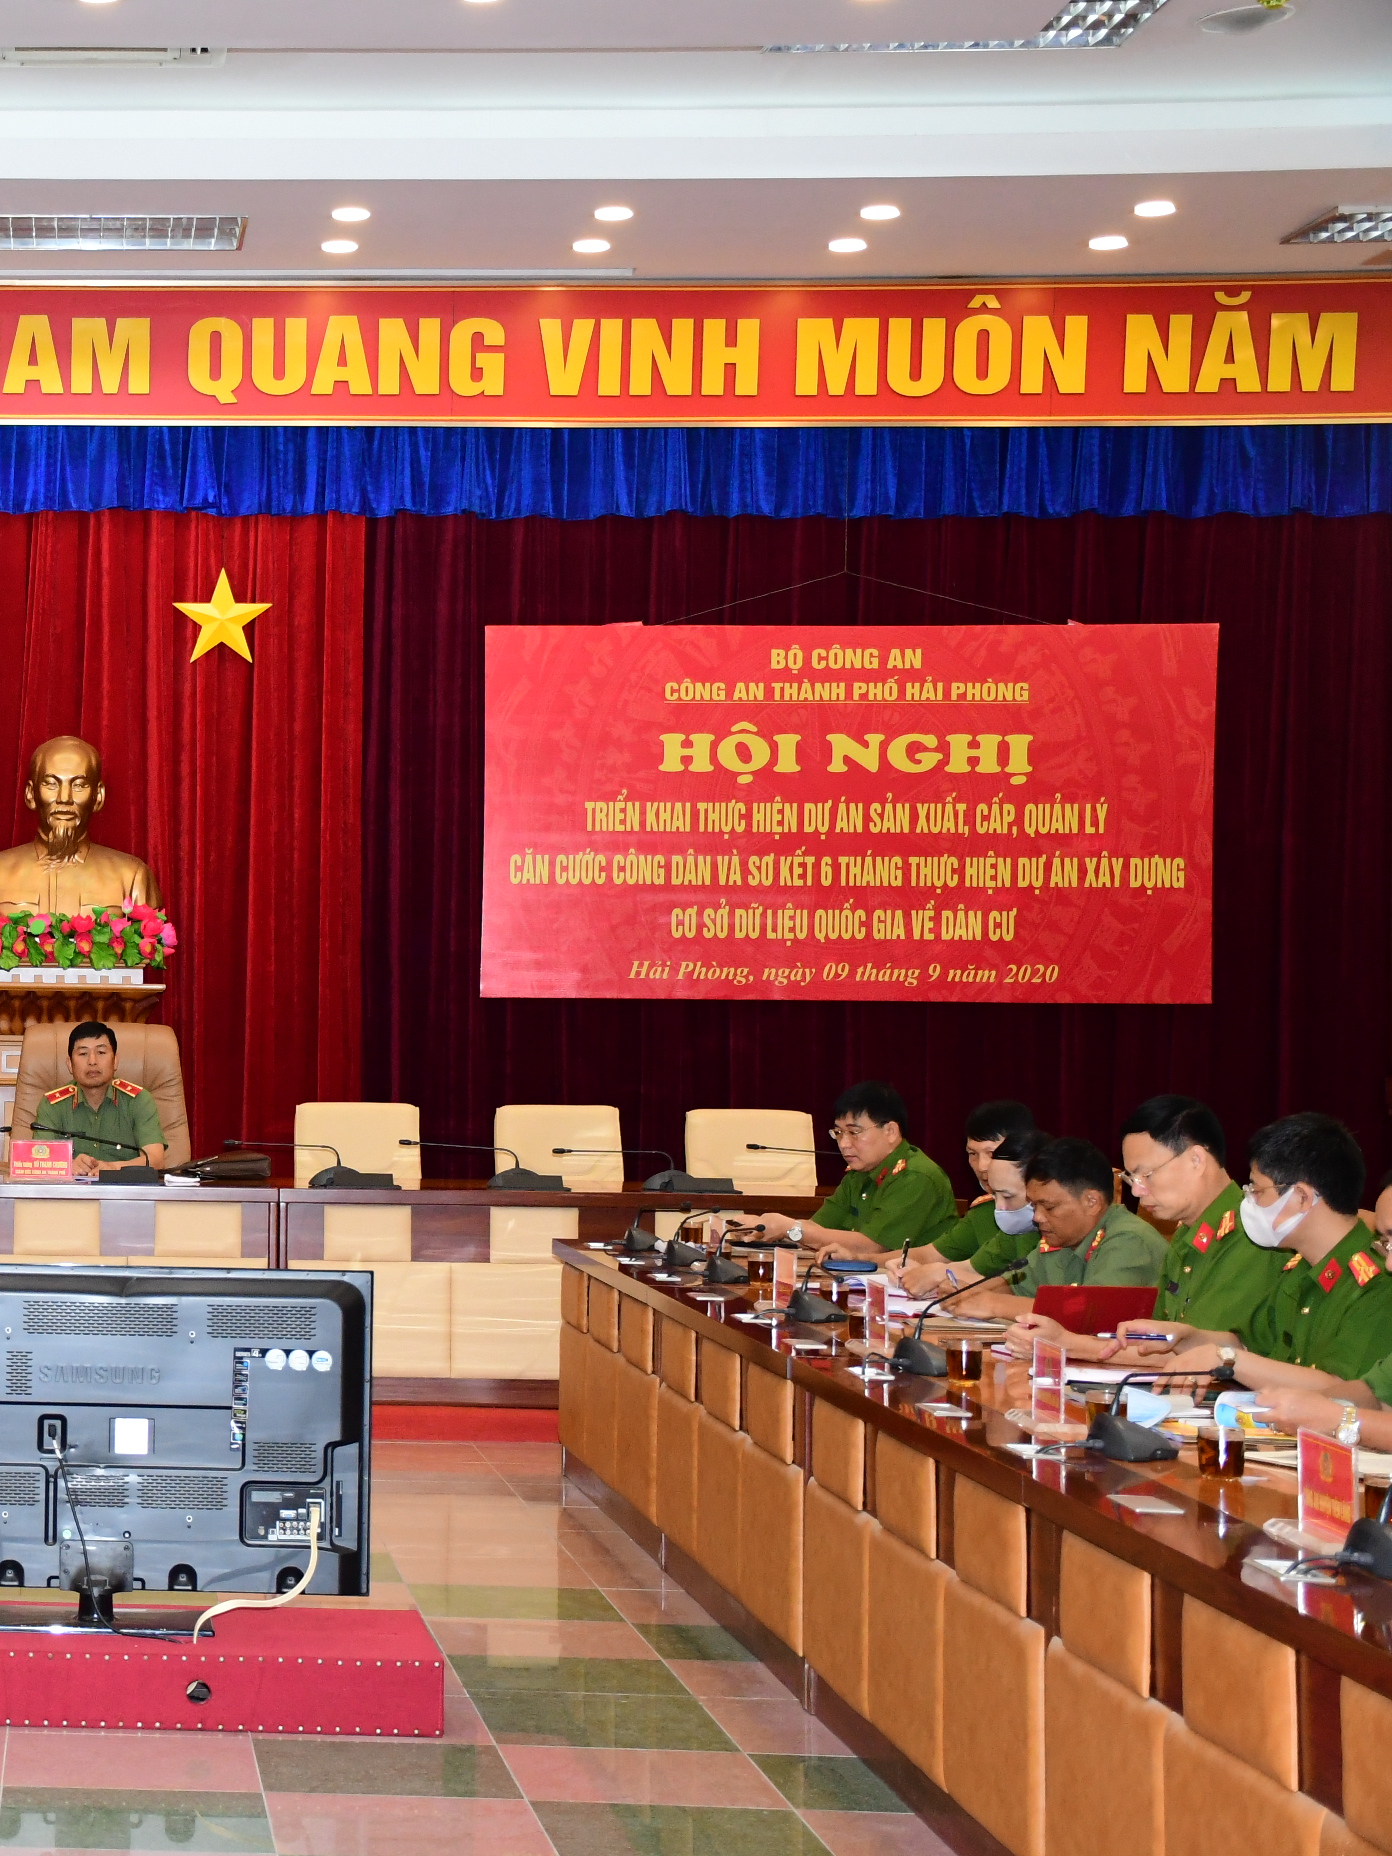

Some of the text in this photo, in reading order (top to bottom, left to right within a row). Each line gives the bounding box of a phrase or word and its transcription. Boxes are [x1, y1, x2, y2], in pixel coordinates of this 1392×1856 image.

[186, 316, 505, 404] QUANG
[540, 318, 759, 396] VINH
[795, 294, 1087, 398] MUÔN
[1123, 290, 1359, 394] NĂM
[770, 645, 922, 673] BỘ CÔNG AN
[664, 676, 1028, 701] CÔNG AN THÀNH PHỐ HẢI PHÒNG
[658, 721, 1034, 785] HỘI NGHỊ
[585, 789, 1108, 839] TRIỂN KHAI THỰC HIỆN DỰ ÁN SẢN XUẤT, CẤP, QUẢN LÝ
[510, 846, 1184, 894] CĂN CƯỚC CÔNG DÂN VÀ SƠ KẾT 6 THÁNG THỰC HIỆN DỰ ÁN XÂY DỰNG
[671, 899, 1017, 946] CƠ SỞ DỮ LIỆU QUỐC GIA VỀ DÂN CƯ
[628, 959, 1059, 986] Hải Phòng, ngày 09 tháng 9 năm 2020
[39, 1364, 161, 1386] SAMSUNG
